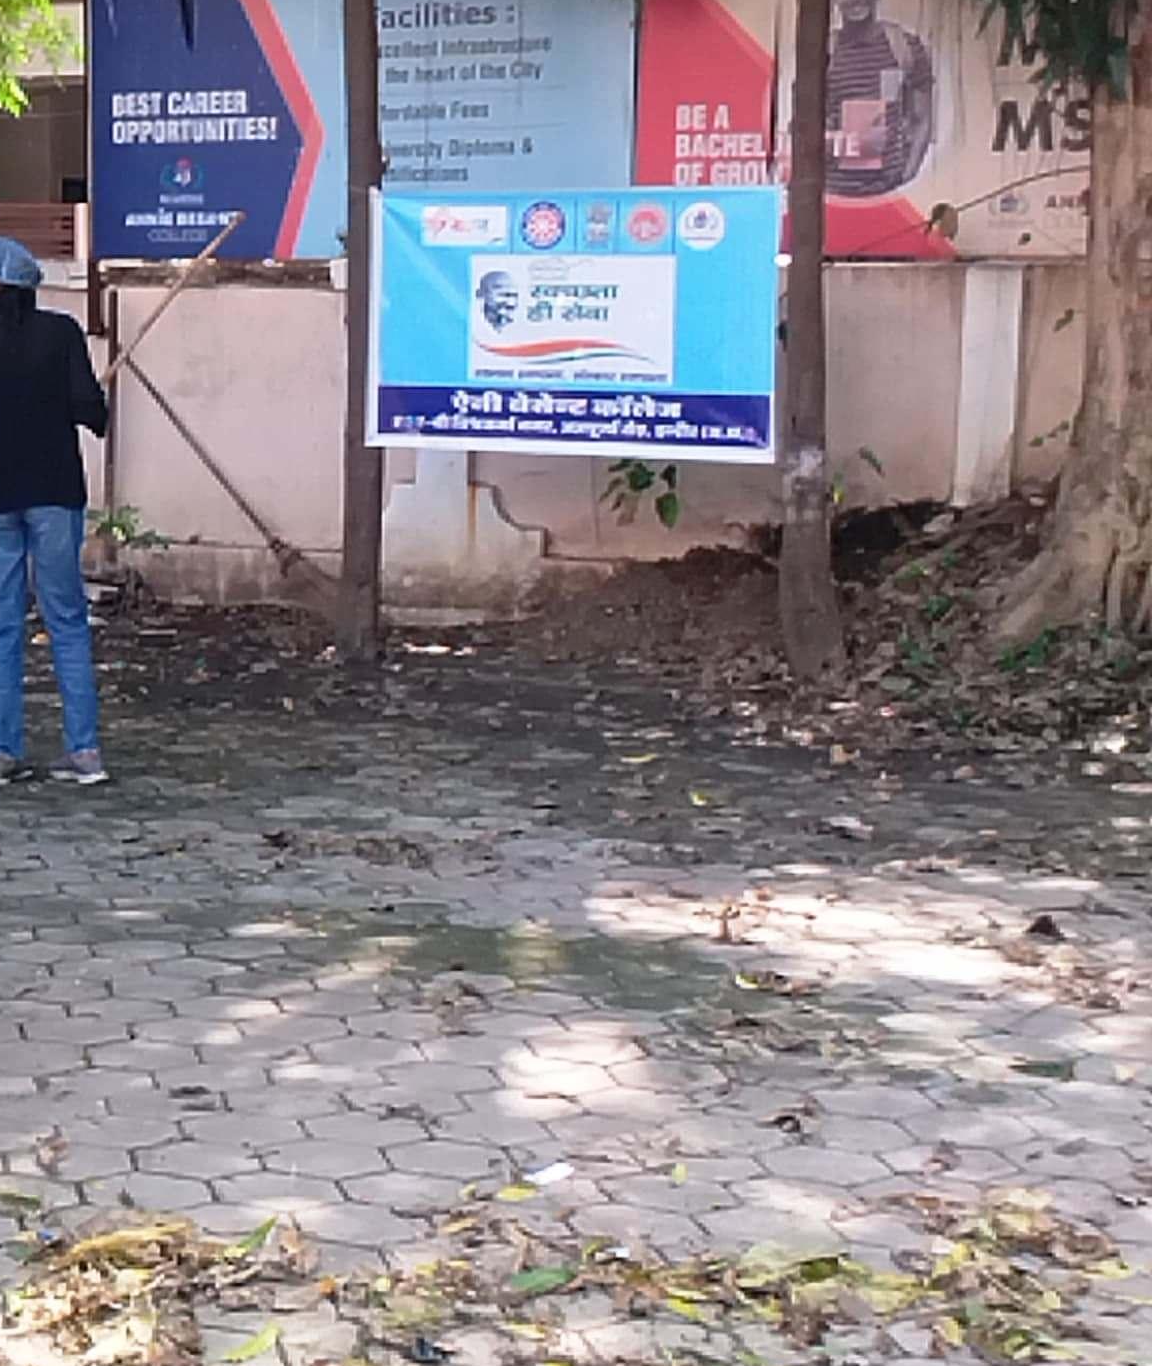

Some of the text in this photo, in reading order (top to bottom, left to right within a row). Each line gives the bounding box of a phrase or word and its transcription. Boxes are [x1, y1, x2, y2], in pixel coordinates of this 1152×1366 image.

[378, 2, 497, 29] acilities
[442, 36, 552, 56] Infrastructure
[386, 67, 409, 83] the
[415, 66, 455, 81] heart
[459, 64, 477, 80] of
[480, 64, 506, 79] the
[111, 90, 247, 117] BEST CAREER
[450, 101, 489, 118] Fees
[675, 104, 730, 130] BE A
[111, 117, 278, 144] OPPORTUNITIES!
[449, 139, 515, 156] Diploma
